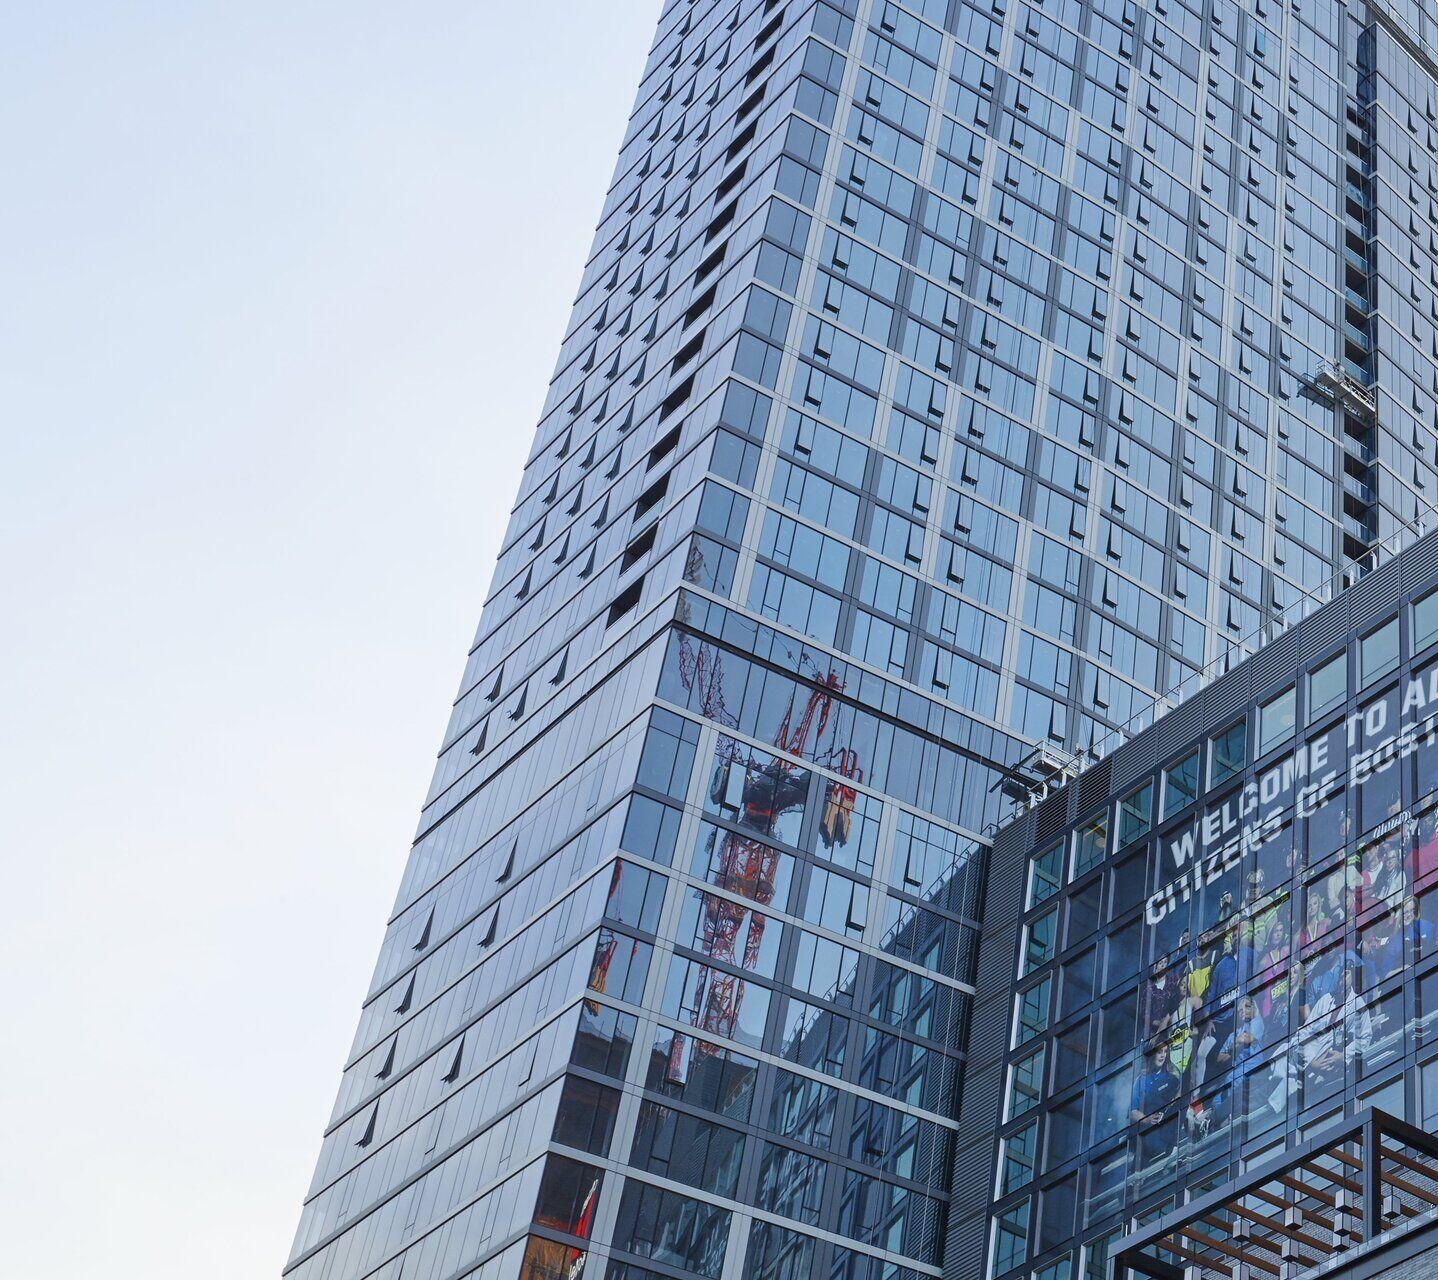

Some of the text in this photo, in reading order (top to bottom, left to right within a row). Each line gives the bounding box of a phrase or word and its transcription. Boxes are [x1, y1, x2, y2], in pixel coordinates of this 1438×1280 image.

[1145, 806, 1285, 926] CITIZENS
[1296, 770, 1337, 819] OF
[1171, 735, 1328, 869] WELCOME
[1344, 699, 1386, 748] TO
